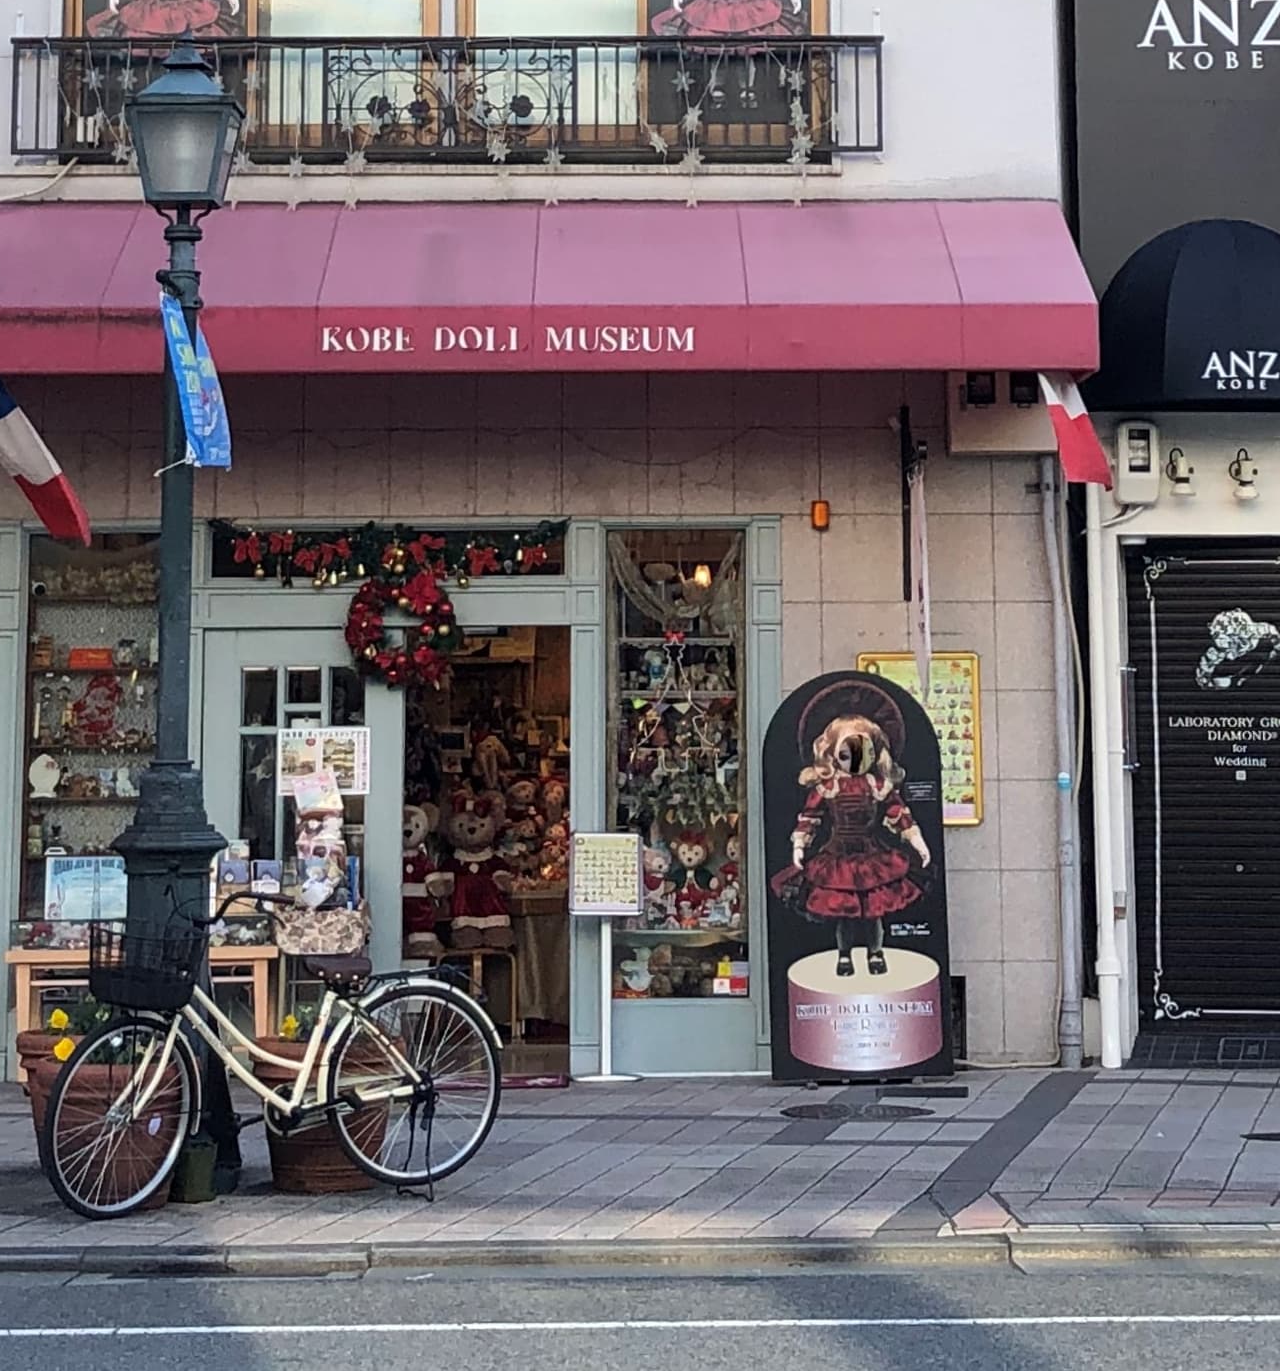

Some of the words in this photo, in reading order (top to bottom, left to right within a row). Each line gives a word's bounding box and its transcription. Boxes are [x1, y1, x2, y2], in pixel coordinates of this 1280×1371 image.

[1168, 50, 1264, 71] KOBE
[321, 326, 415, 352] KOBE
[434, 326, 528, 353] DOLL
[545, 326, 695, 352] MUSEUM
[1200, 350, 1280, 379] ANZ
[1216, 379, 1267, 391] KOBE
[1169, 716, 1255, 729] LABORATORY
[1232, 743, 1248, 754] for
[1214, 756, 1267, 768] Wedding
